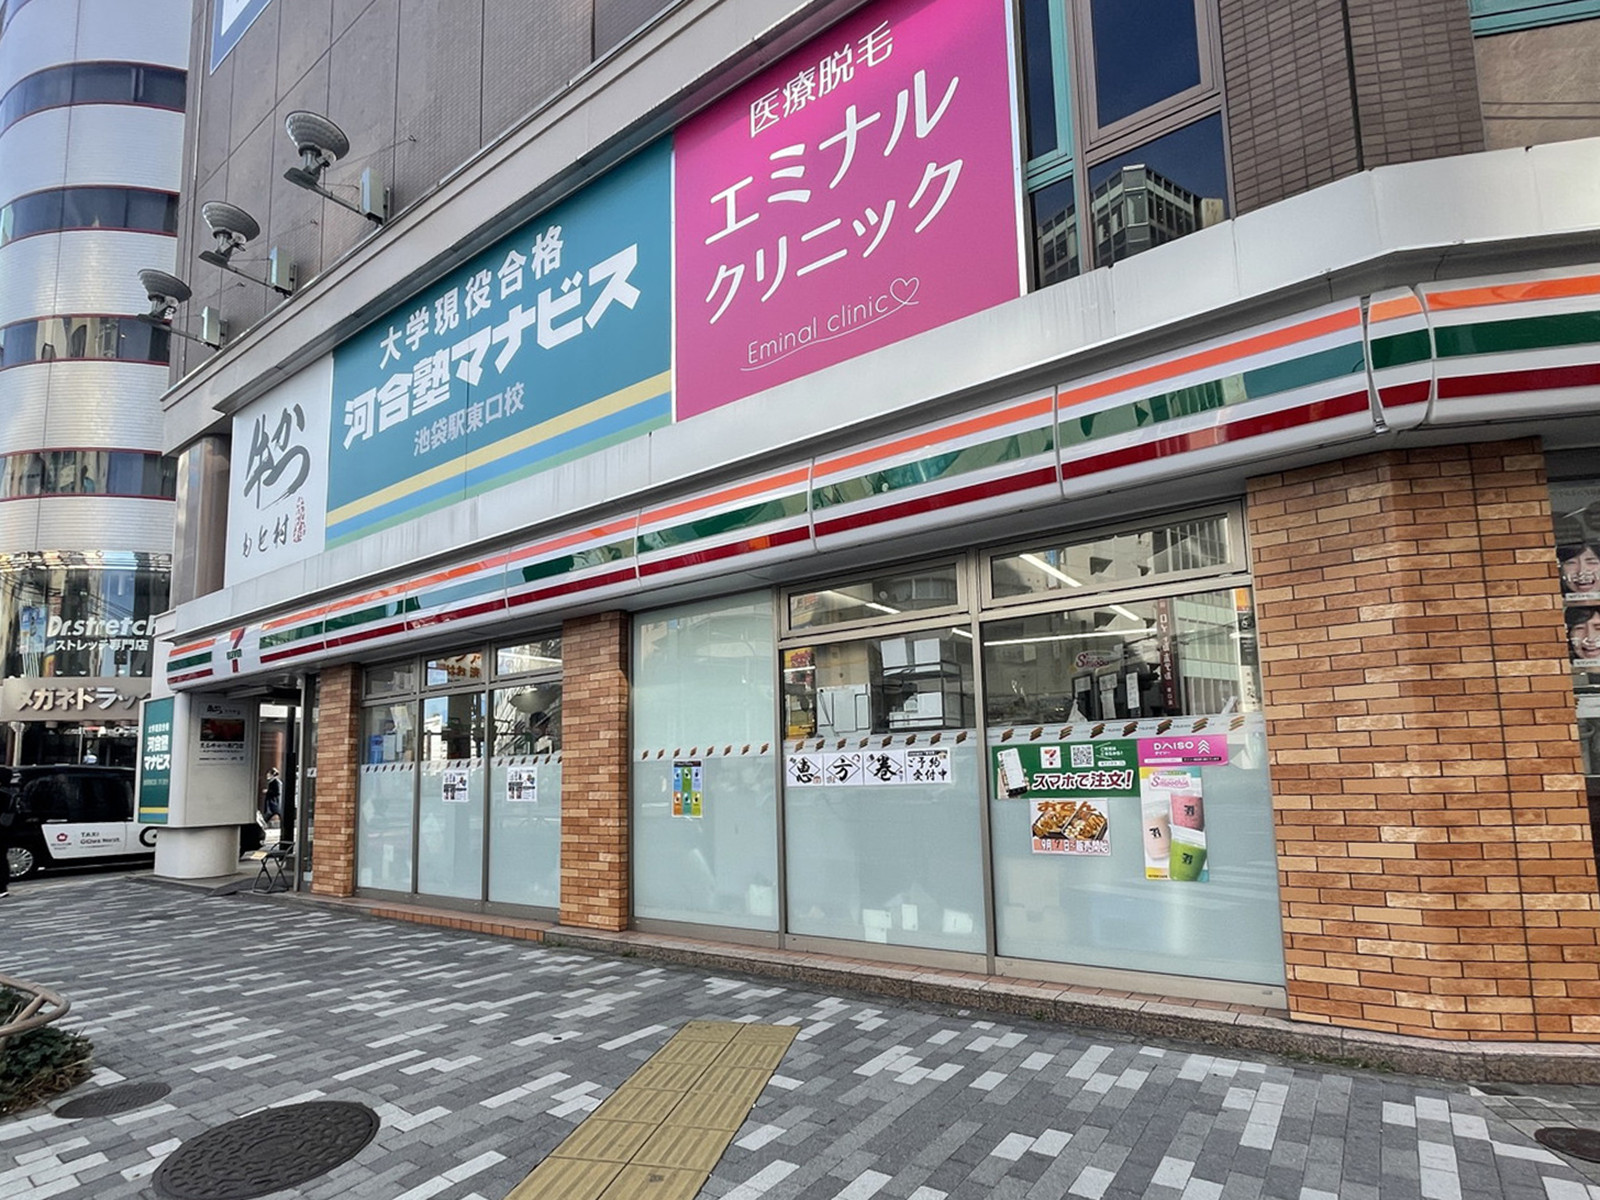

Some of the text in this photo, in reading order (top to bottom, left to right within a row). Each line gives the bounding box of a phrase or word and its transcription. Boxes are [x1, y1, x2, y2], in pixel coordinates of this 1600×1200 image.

[750, 20, 893, 138] 医療脱毛
[705, 69, 959, 245] エミナル
[705, 159, 963, 324] クリニック
[379, 225, 564, 370] 大学現役合格
[343, 243, 641, 450] 河合塾マナビス
[747, 293, 888, 364] Eminal clinic
[413, 381, 525, 457] 池袋駅東口校
[56, 639, 149, 651] ストレッチ専門店
[18, 686, 151, 711] メガネドラッ
[144, 754, 171, 771] マナビス
[908, 756, 941, 768] ご予約
[1153, 741, 1194, 750] DAISO
[913, 769, 948, 782] 受付中
[1032, 770, 1134, 790] スマホで注文!
